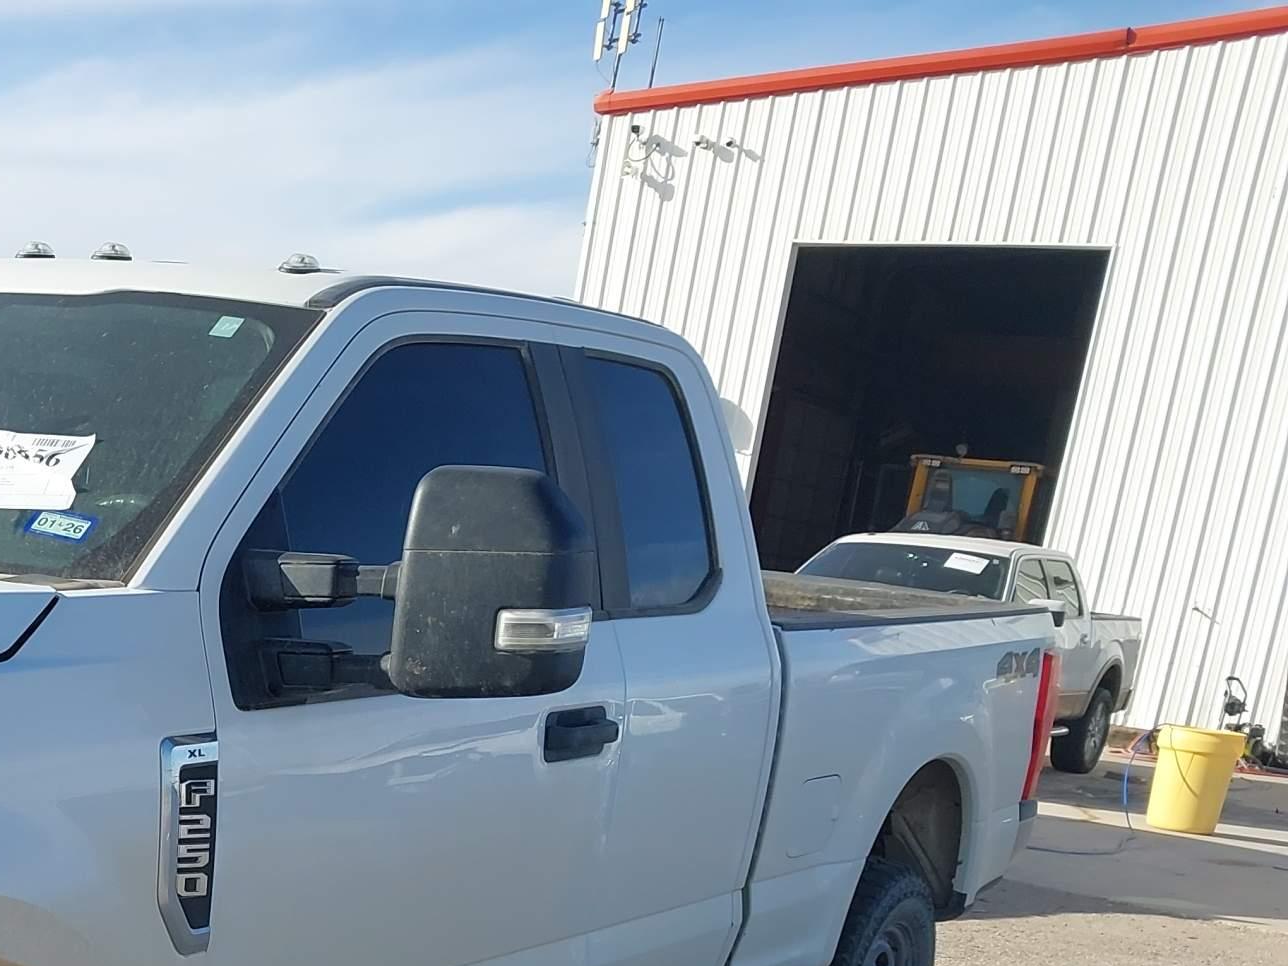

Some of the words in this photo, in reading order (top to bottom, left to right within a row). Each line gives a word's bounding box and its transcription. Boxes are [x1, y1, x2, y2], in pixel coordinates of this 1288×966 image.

[37, 516, 57, 529] 01
[62, 521, 85, 534] 26
[187, 748, 206, 759] XL
